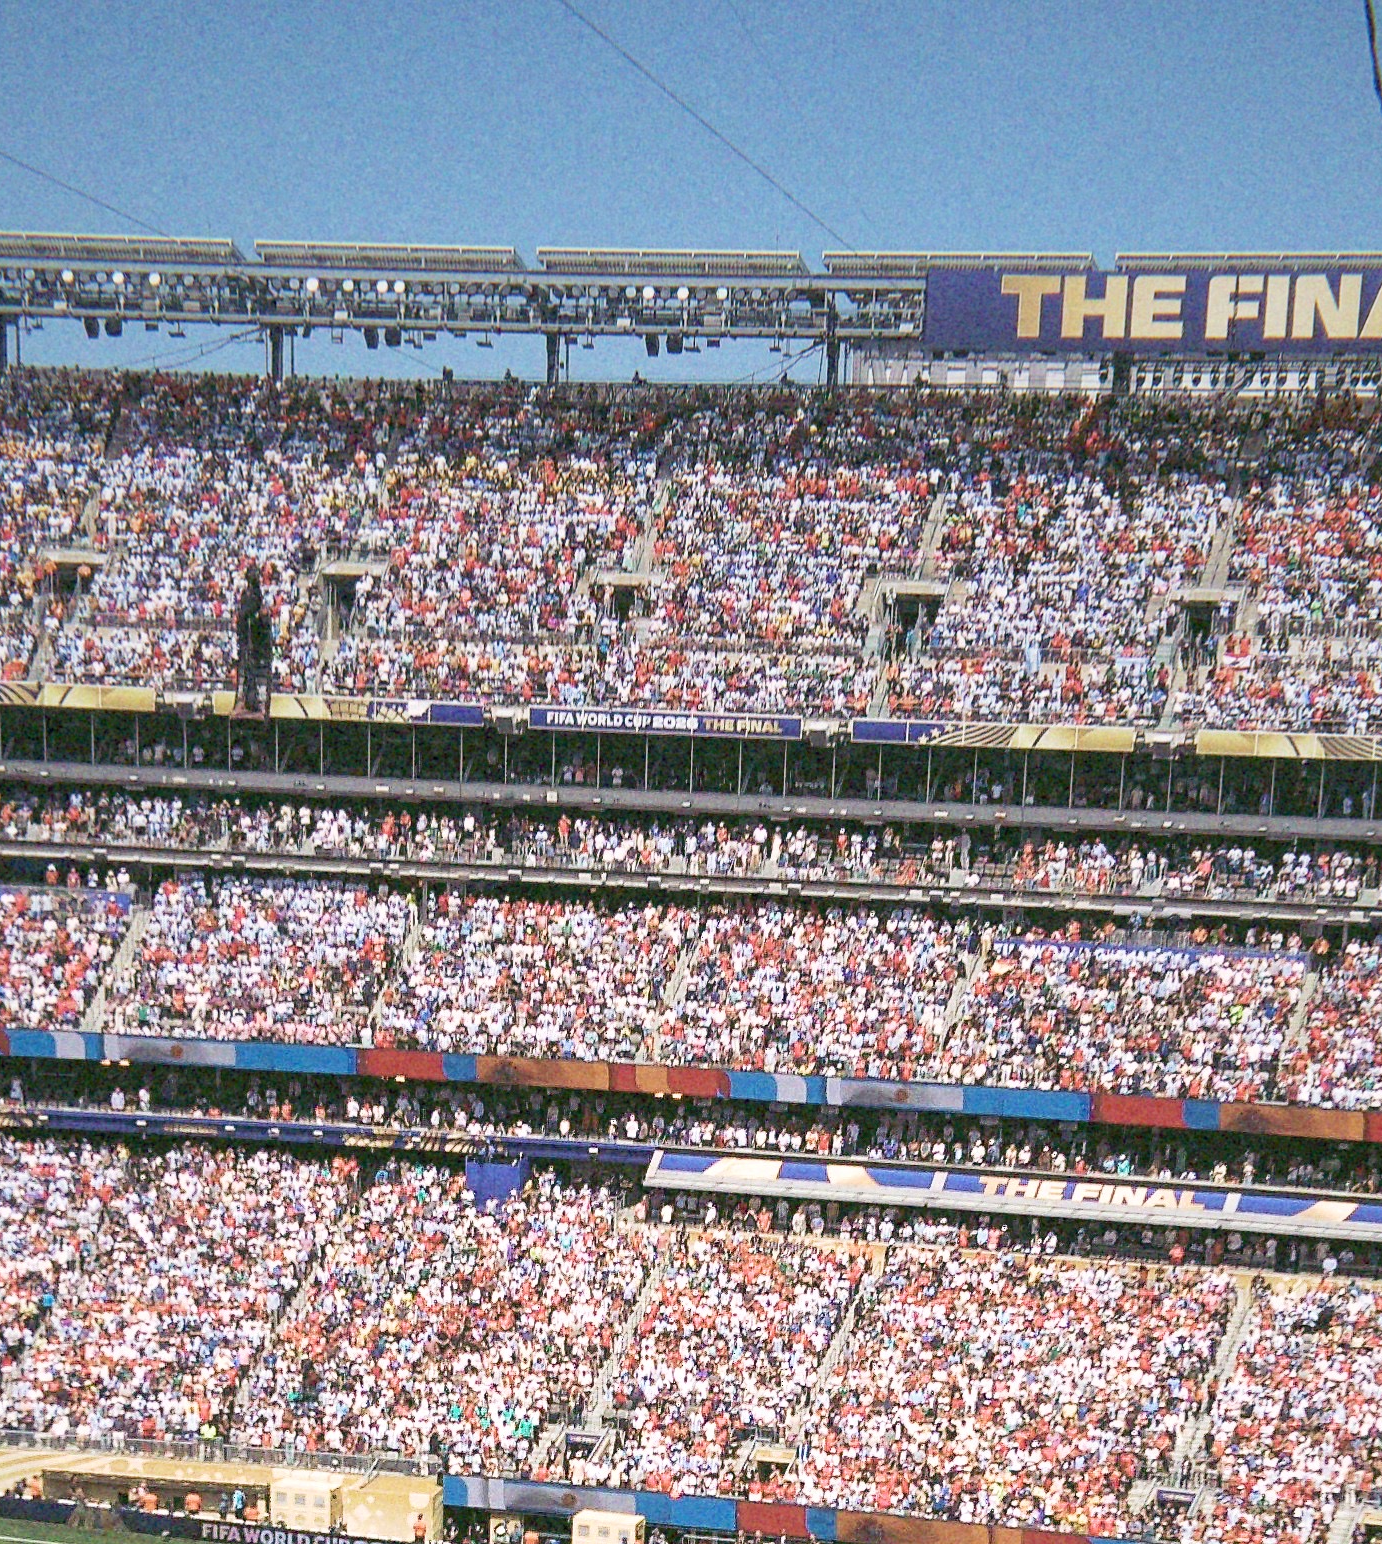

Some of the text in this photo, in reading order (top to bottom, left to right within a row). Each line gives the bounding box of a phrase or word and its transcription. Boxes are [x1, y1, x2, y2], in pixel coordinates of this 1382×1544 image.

[1002, 273, 1187, 339] THE
[546, 711, 782, 735] FIFA WORLD CUP 2026 THE FINAL
[979, 1175, 1206, 1211] THE FINAL
[202, 1523, 241, 1543] FIFA
